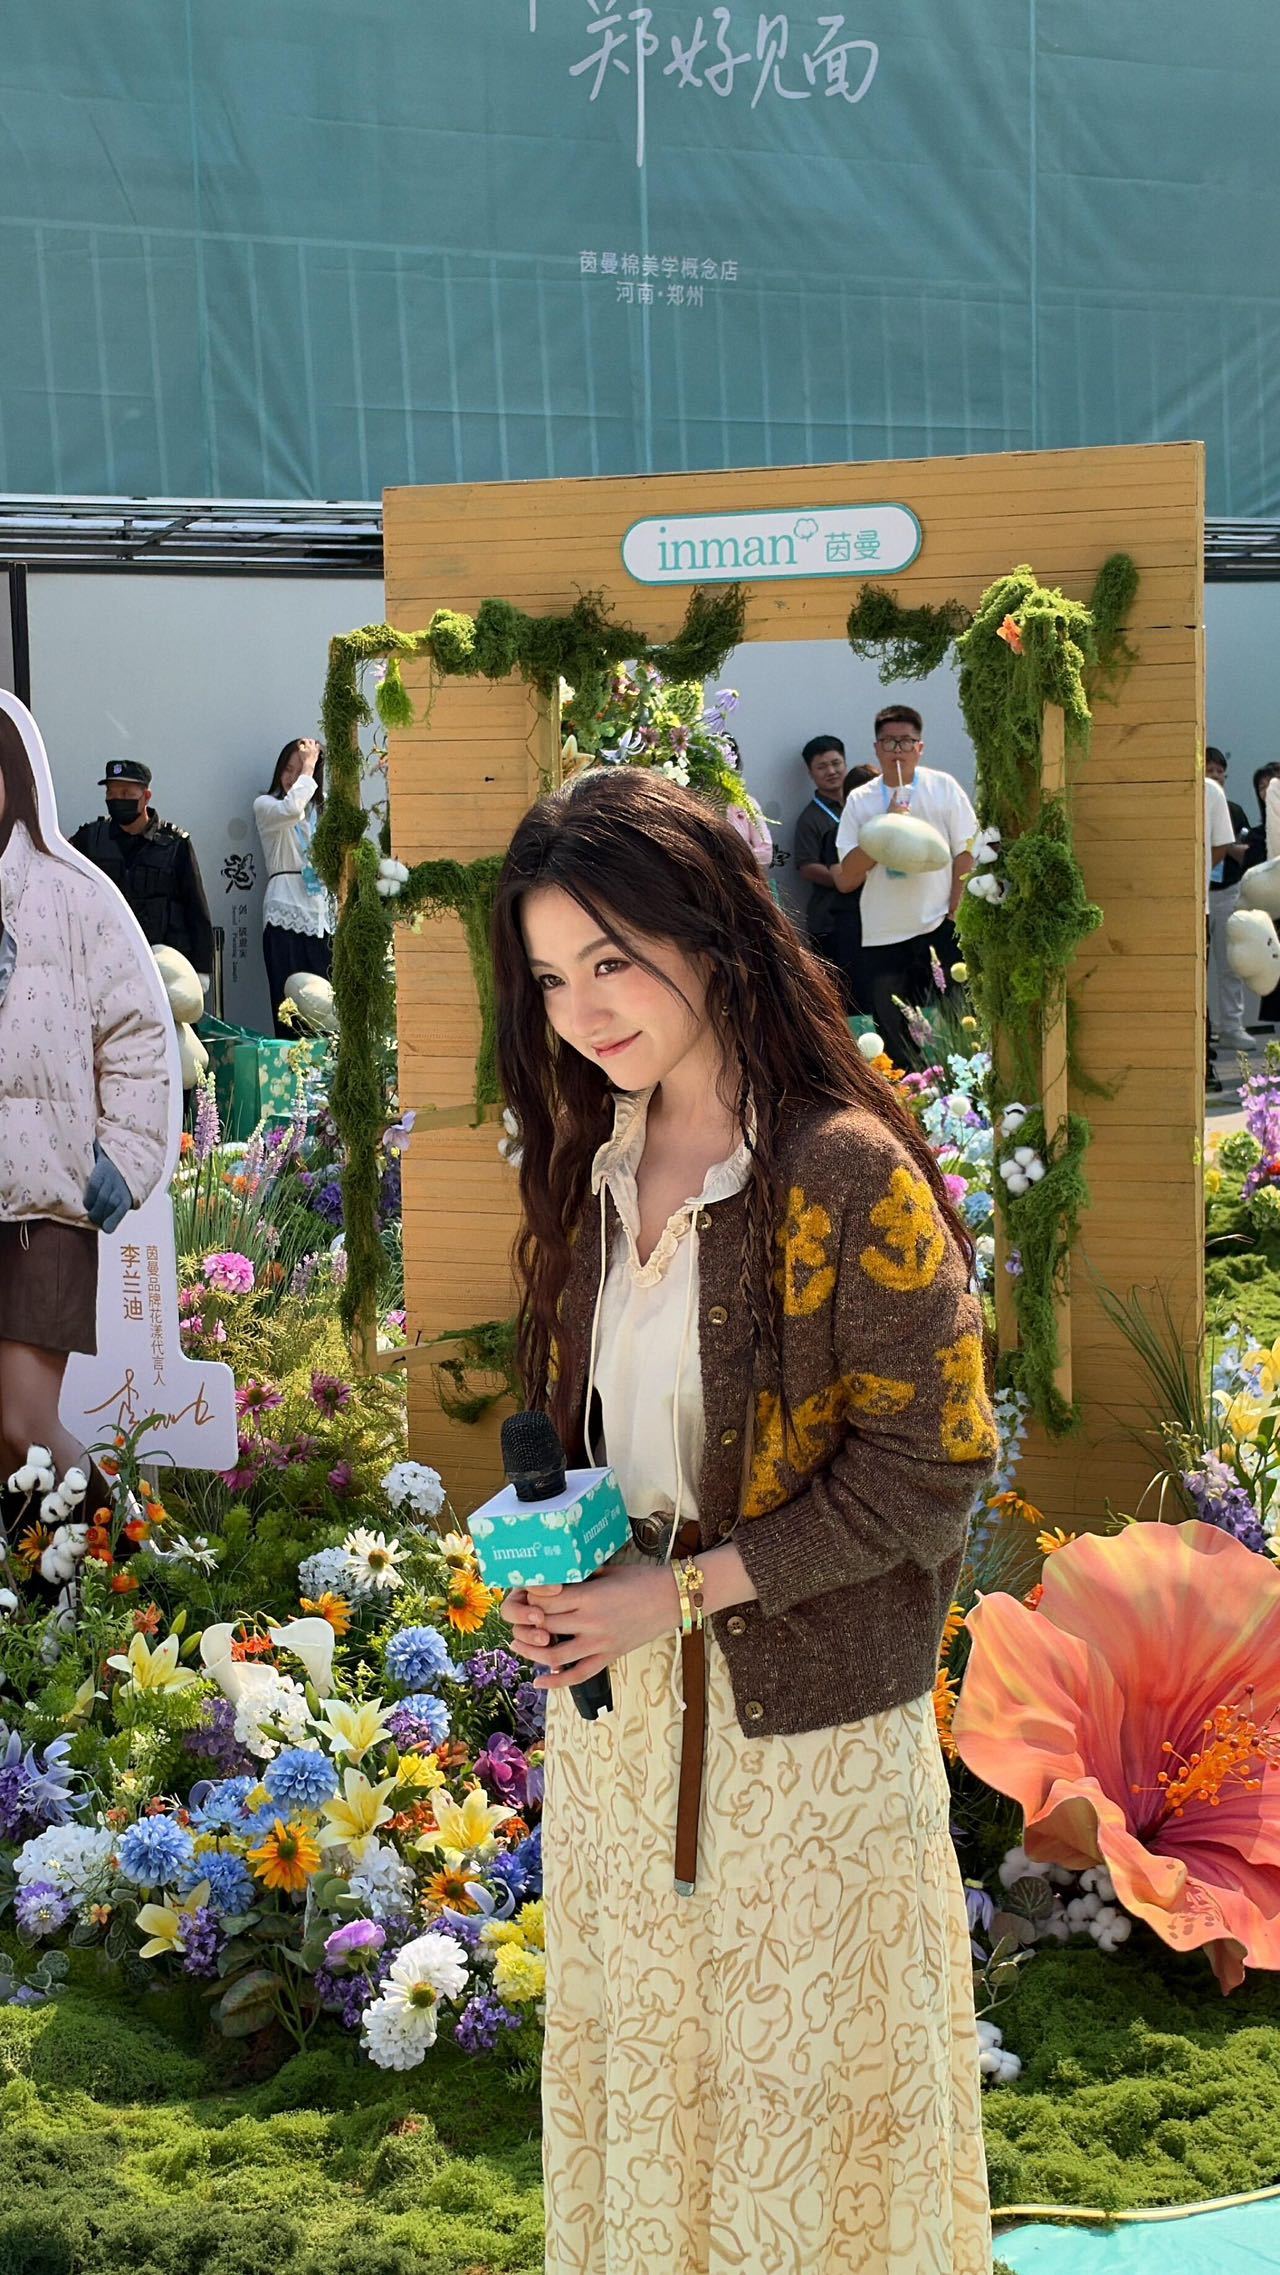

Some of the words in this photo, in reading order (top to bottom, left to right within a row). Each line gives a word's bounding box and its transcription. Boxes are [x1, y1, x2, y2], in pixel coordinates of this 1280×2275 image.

[578, 250, 739, 281] 茵曼棉美学概念店
[616, 281, 704, 307] 河南·郑州
[657, 526, 798, 571] inman
[825, 529, 881, 563] 茵曼
[120, 1244, 144, 1321] 李兰迪
[583, 1516, 609, 1544] inman
[492, 1545, 537, 1560] inman
